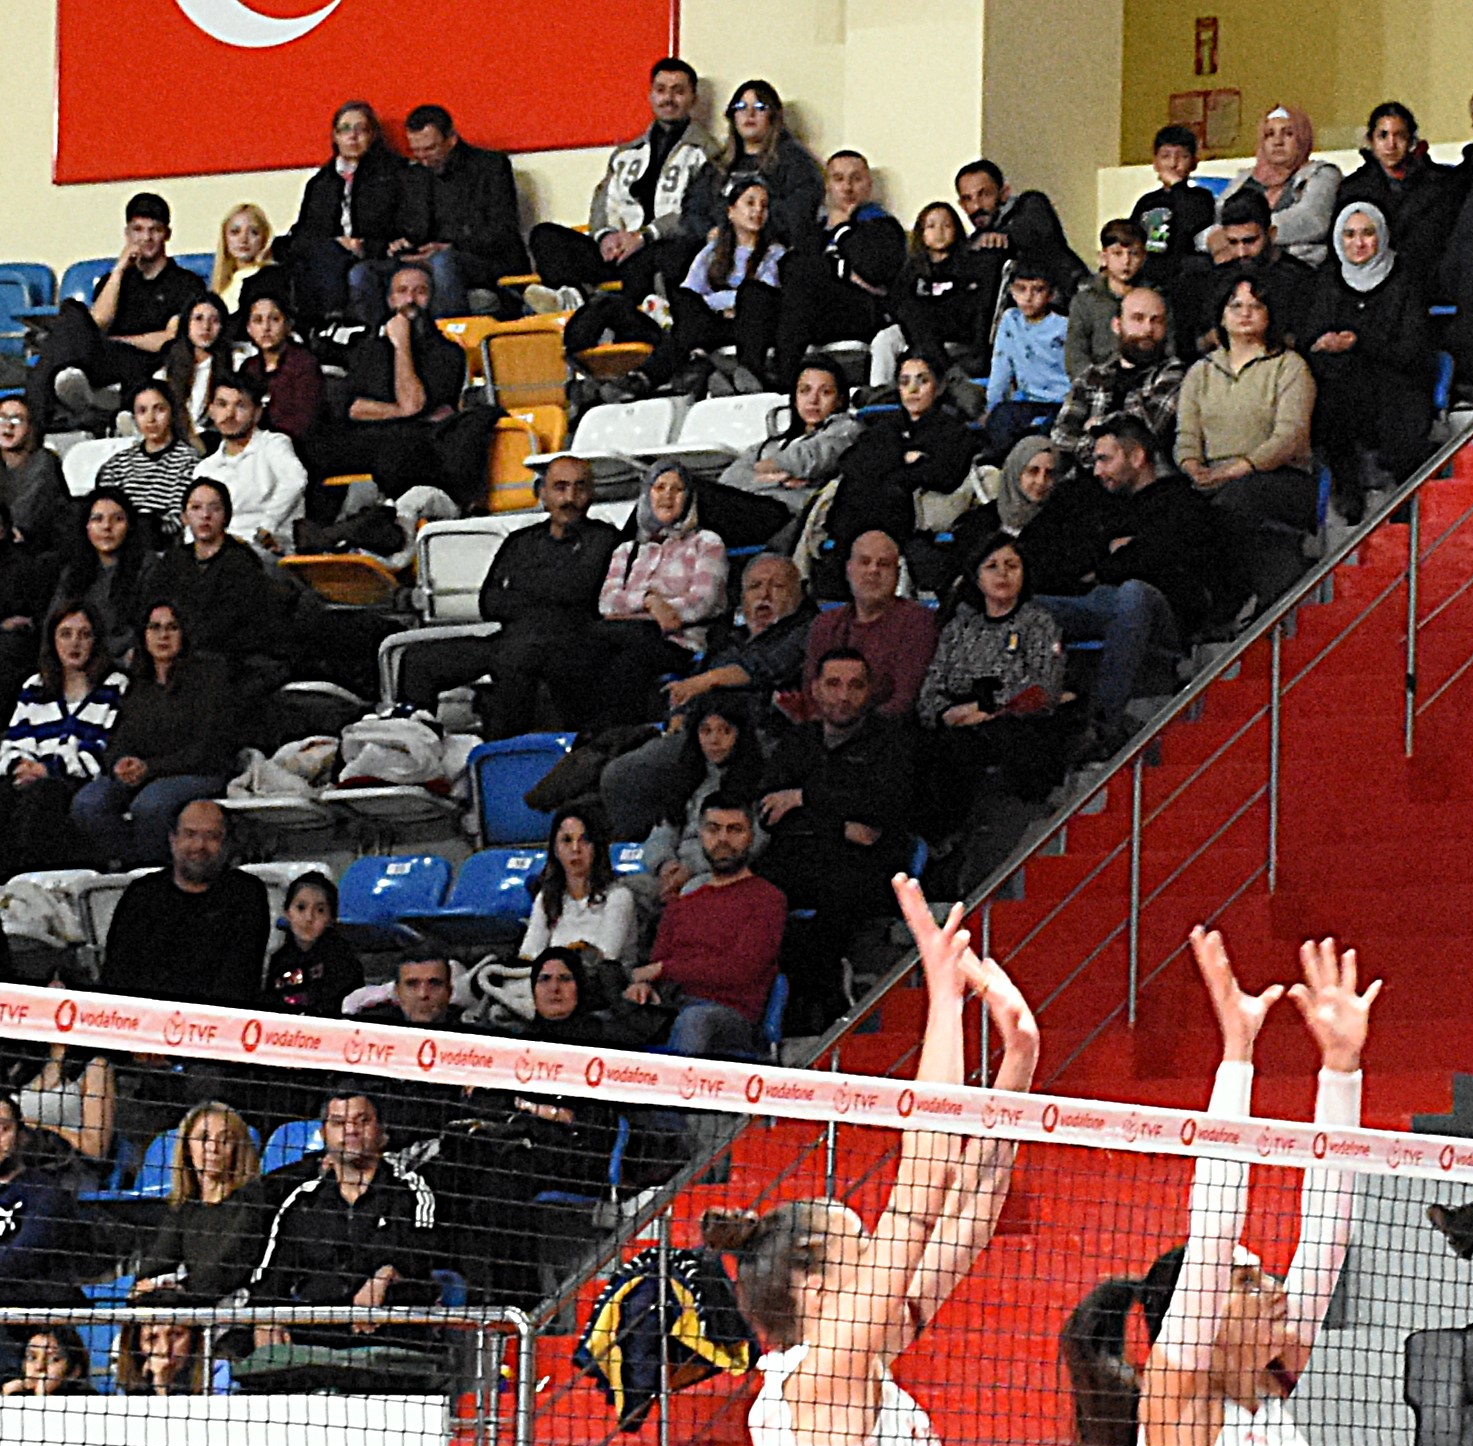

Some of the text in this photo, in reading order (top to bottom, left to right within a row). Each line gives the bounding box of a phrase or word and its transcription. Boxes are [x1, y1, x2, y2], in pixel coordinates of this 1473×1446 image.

[79, 1010, 140, 1031] vodafone
[188, 1024, 218, 1044] TVF
[265, 1030, 322, 1050] vodafone
[367, 1043, 395, 1064] TVF
[439, 1048, 494, 1069] vodafone
[536, 1062, 563, 1081] TVF
[606, 1065, 659, 1086] vodafone
[700, 1079, 725, 1099] TVF
[765, 1083, 815, 1102] vodafone
[853, 1094, 879, 1111] TVF
[916, 1098, 964, 1116] vodafone
[1000, 1107, 1024, 1125] TVF
[1059, 1111, 1105, 1130] vodafone
[1139, 1122, 1163, 1139] TVF
[1198, 1126, 1241, 1145] vodafone
[1273, 1136, 1296, 1154] TVF
[1329, 1141, 1371, 1157] vodafone
[1403, 1149, 1424, 1167] TVF
